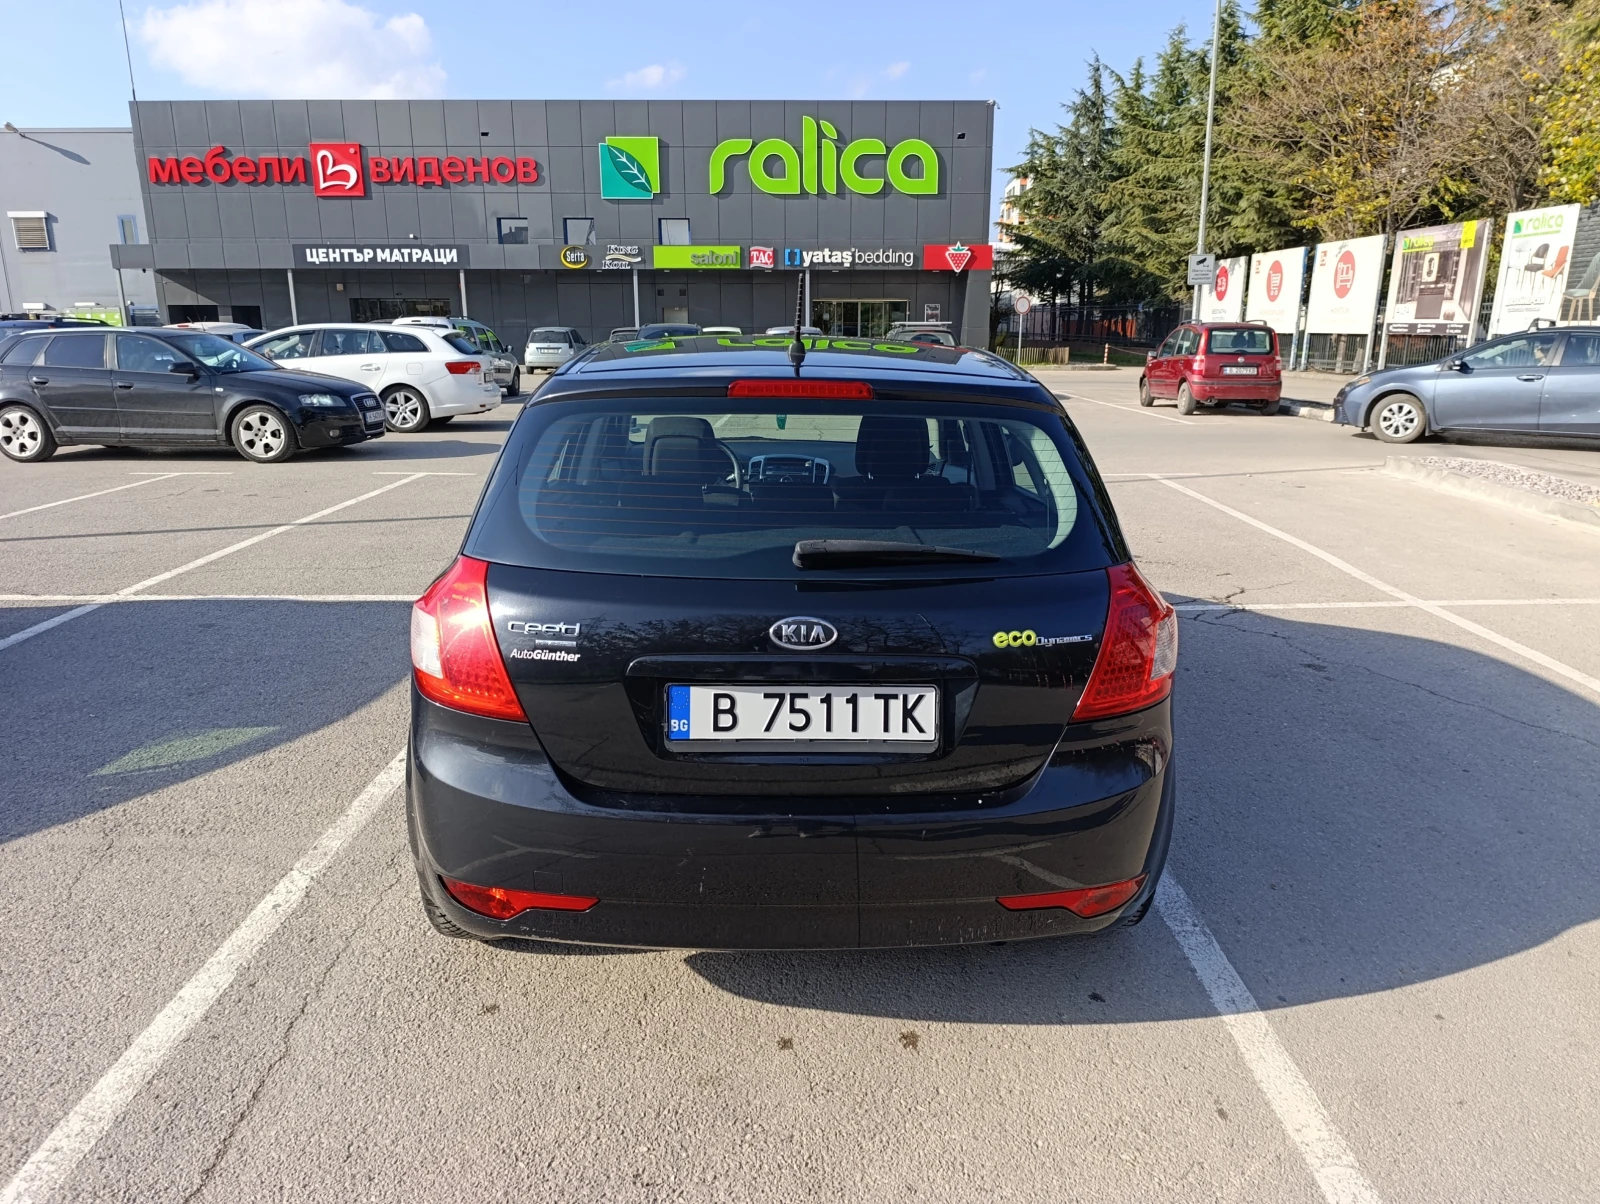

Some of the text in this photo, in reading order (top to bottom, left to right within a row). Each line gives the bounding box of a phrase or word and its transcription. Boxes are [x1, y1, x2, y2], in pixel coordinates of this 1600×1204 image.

[709, 115, 938, 194] ralica
[148, 145, 540, 186] мебели виденов
[1526, 212, 1564, 231] ralica
[305, 248, 458, 265] ЦЕНТЪР МАТРАЦИ
[566, 247, 585, 264] Serta
[690, 249, 738, 267] saloni
[751, 250, 773, 267] TAÇ
[855, 248, 914, 267] bedding
[780, 624, 827, 643] KIA
[712, 692, 927, 734] B 7511 TK
[670, 718, 689, 732] BG
